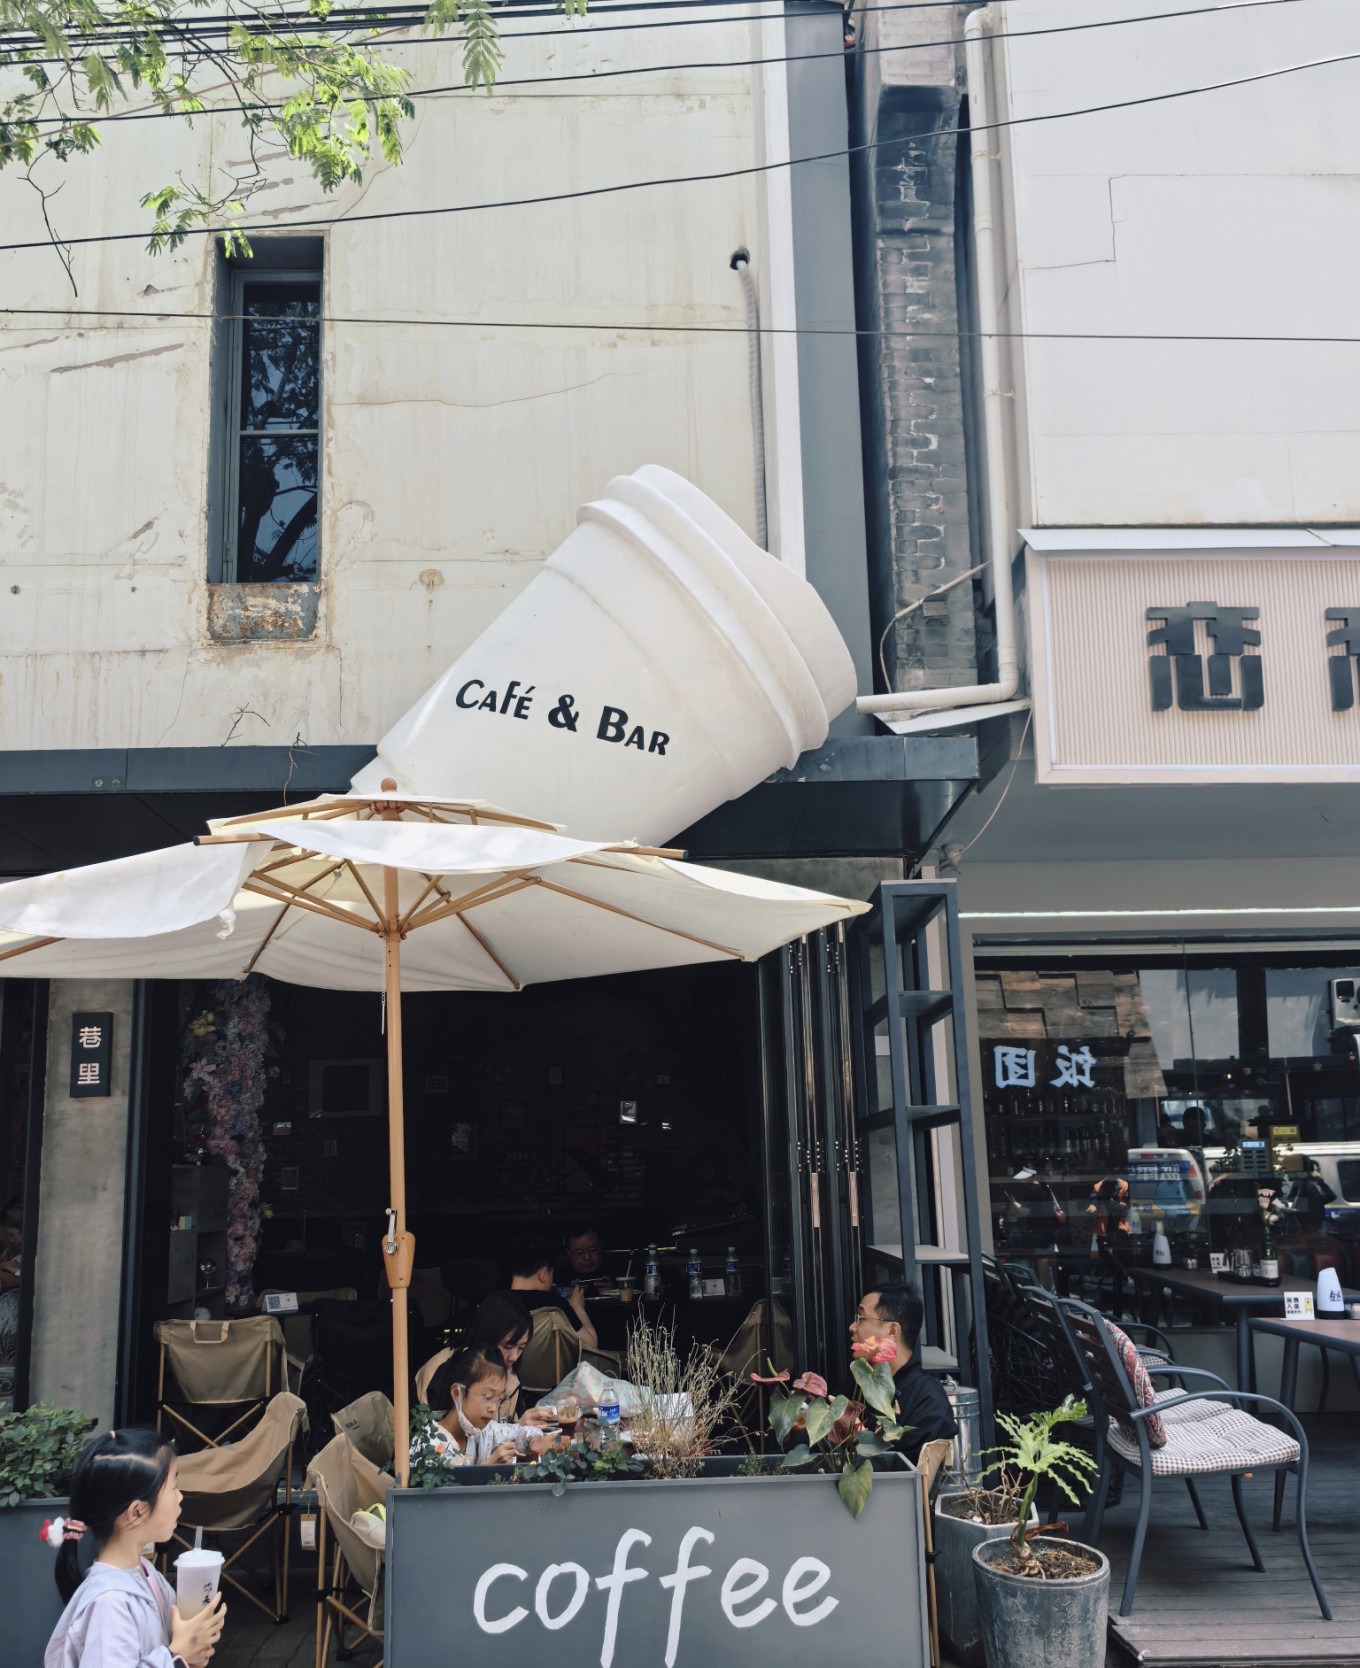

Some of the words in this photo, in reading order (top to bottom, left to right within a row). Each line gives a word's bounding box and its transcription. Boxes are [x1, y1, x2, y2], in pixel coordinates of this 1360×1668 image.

[1146, 601, 1360, 712] 恋
[548, 694, 580, 732] &
[597, 705, 671, 756] BAR
[77, 1026, 102, 1085] 巷里
[473, 1526, 839, 1668] coffee
